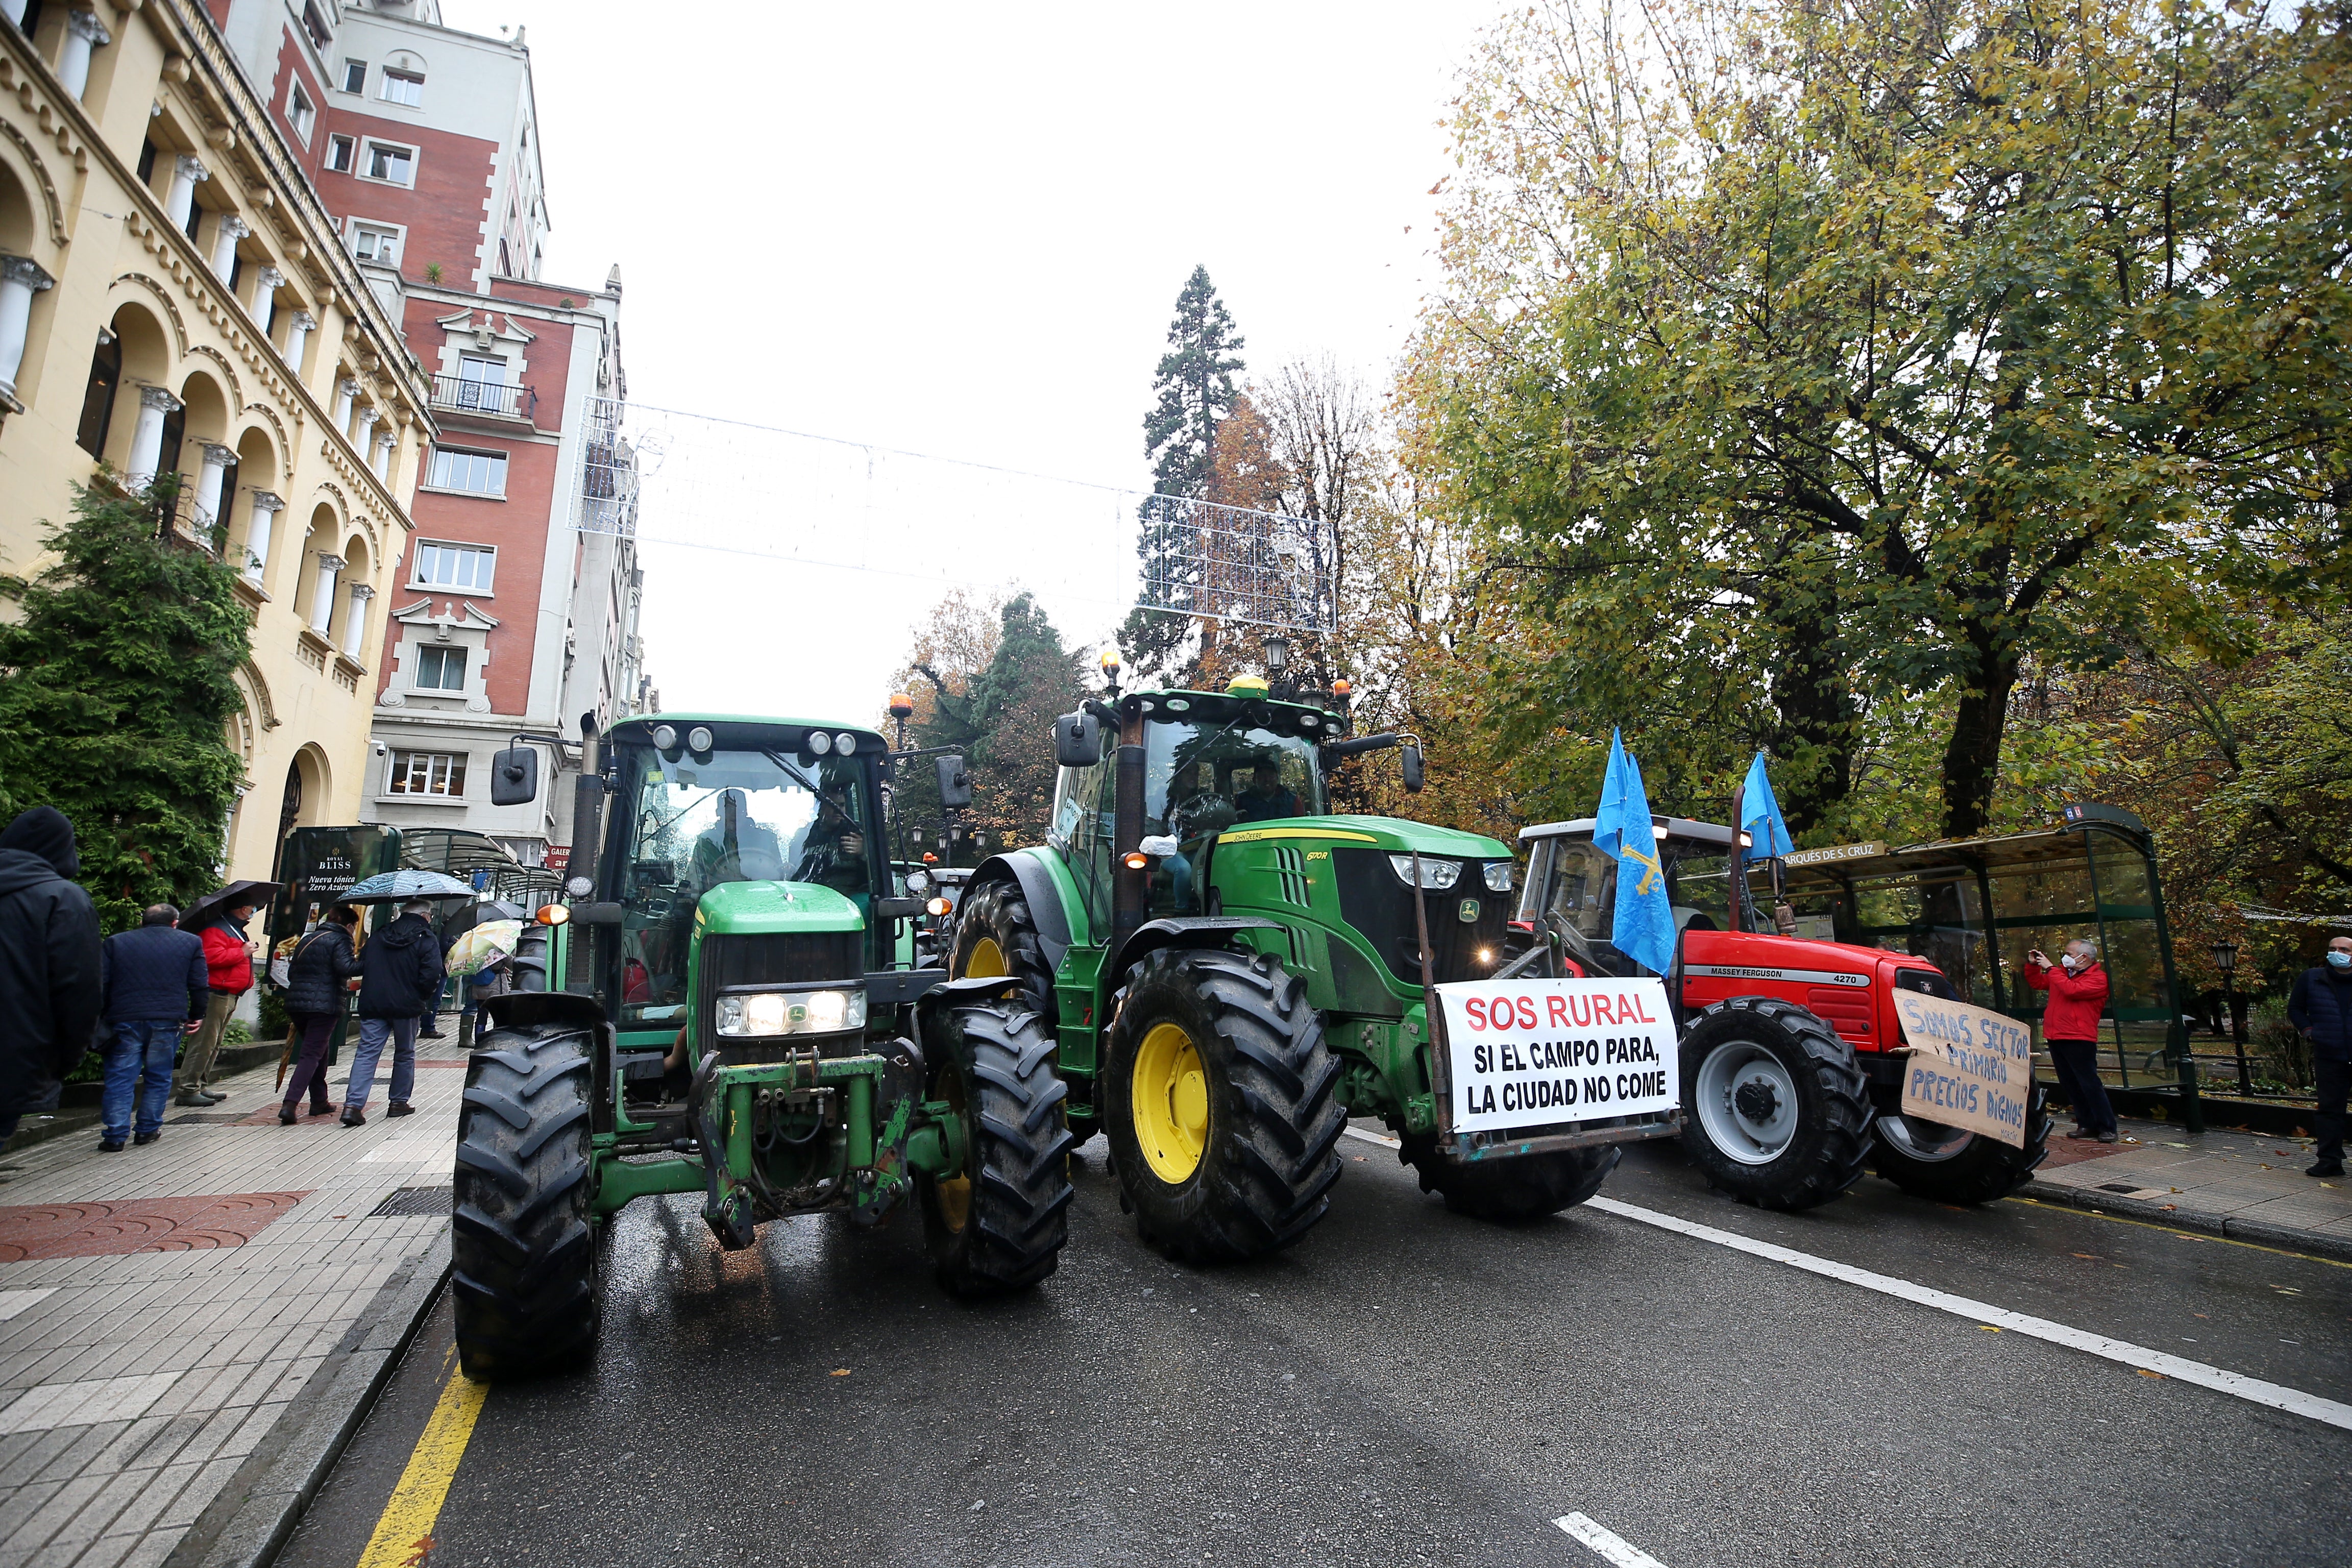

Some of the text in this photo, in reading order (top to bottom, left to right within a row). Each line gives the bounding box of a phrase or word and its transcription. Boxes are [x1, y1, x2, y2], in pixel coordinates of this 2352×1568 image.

[1233, 832, 1262, 842] JOHN DEERE
[551, 848, 570, 856] GALER
[1306, 852, 1328, 861] 6170R
[1822, 849, 1836, 860] DE
[1837, 848, 1846, 859] S.
[1848, 844, 1875, 856] CRUZ
[319, 861, 351, 869] BLISS
[327, 883, 353, 891] Azúcar
[1742, 969, 1782, 977] FERGUSON
[1834, 975, 1856, 984] 4270
[1465, 994, 1656, 1031] SOS RURAL
[1903, 998, 2029, 1060] SOMOS SECTOR
[1474, 1036, 1659, 1073] SI EL CAMPO PARA,
[1468, 1070, 1666, 1114] LA CIUDAD NO COME
[1910, 1068, 2023, 1129] PRECIOS DIGNOS
